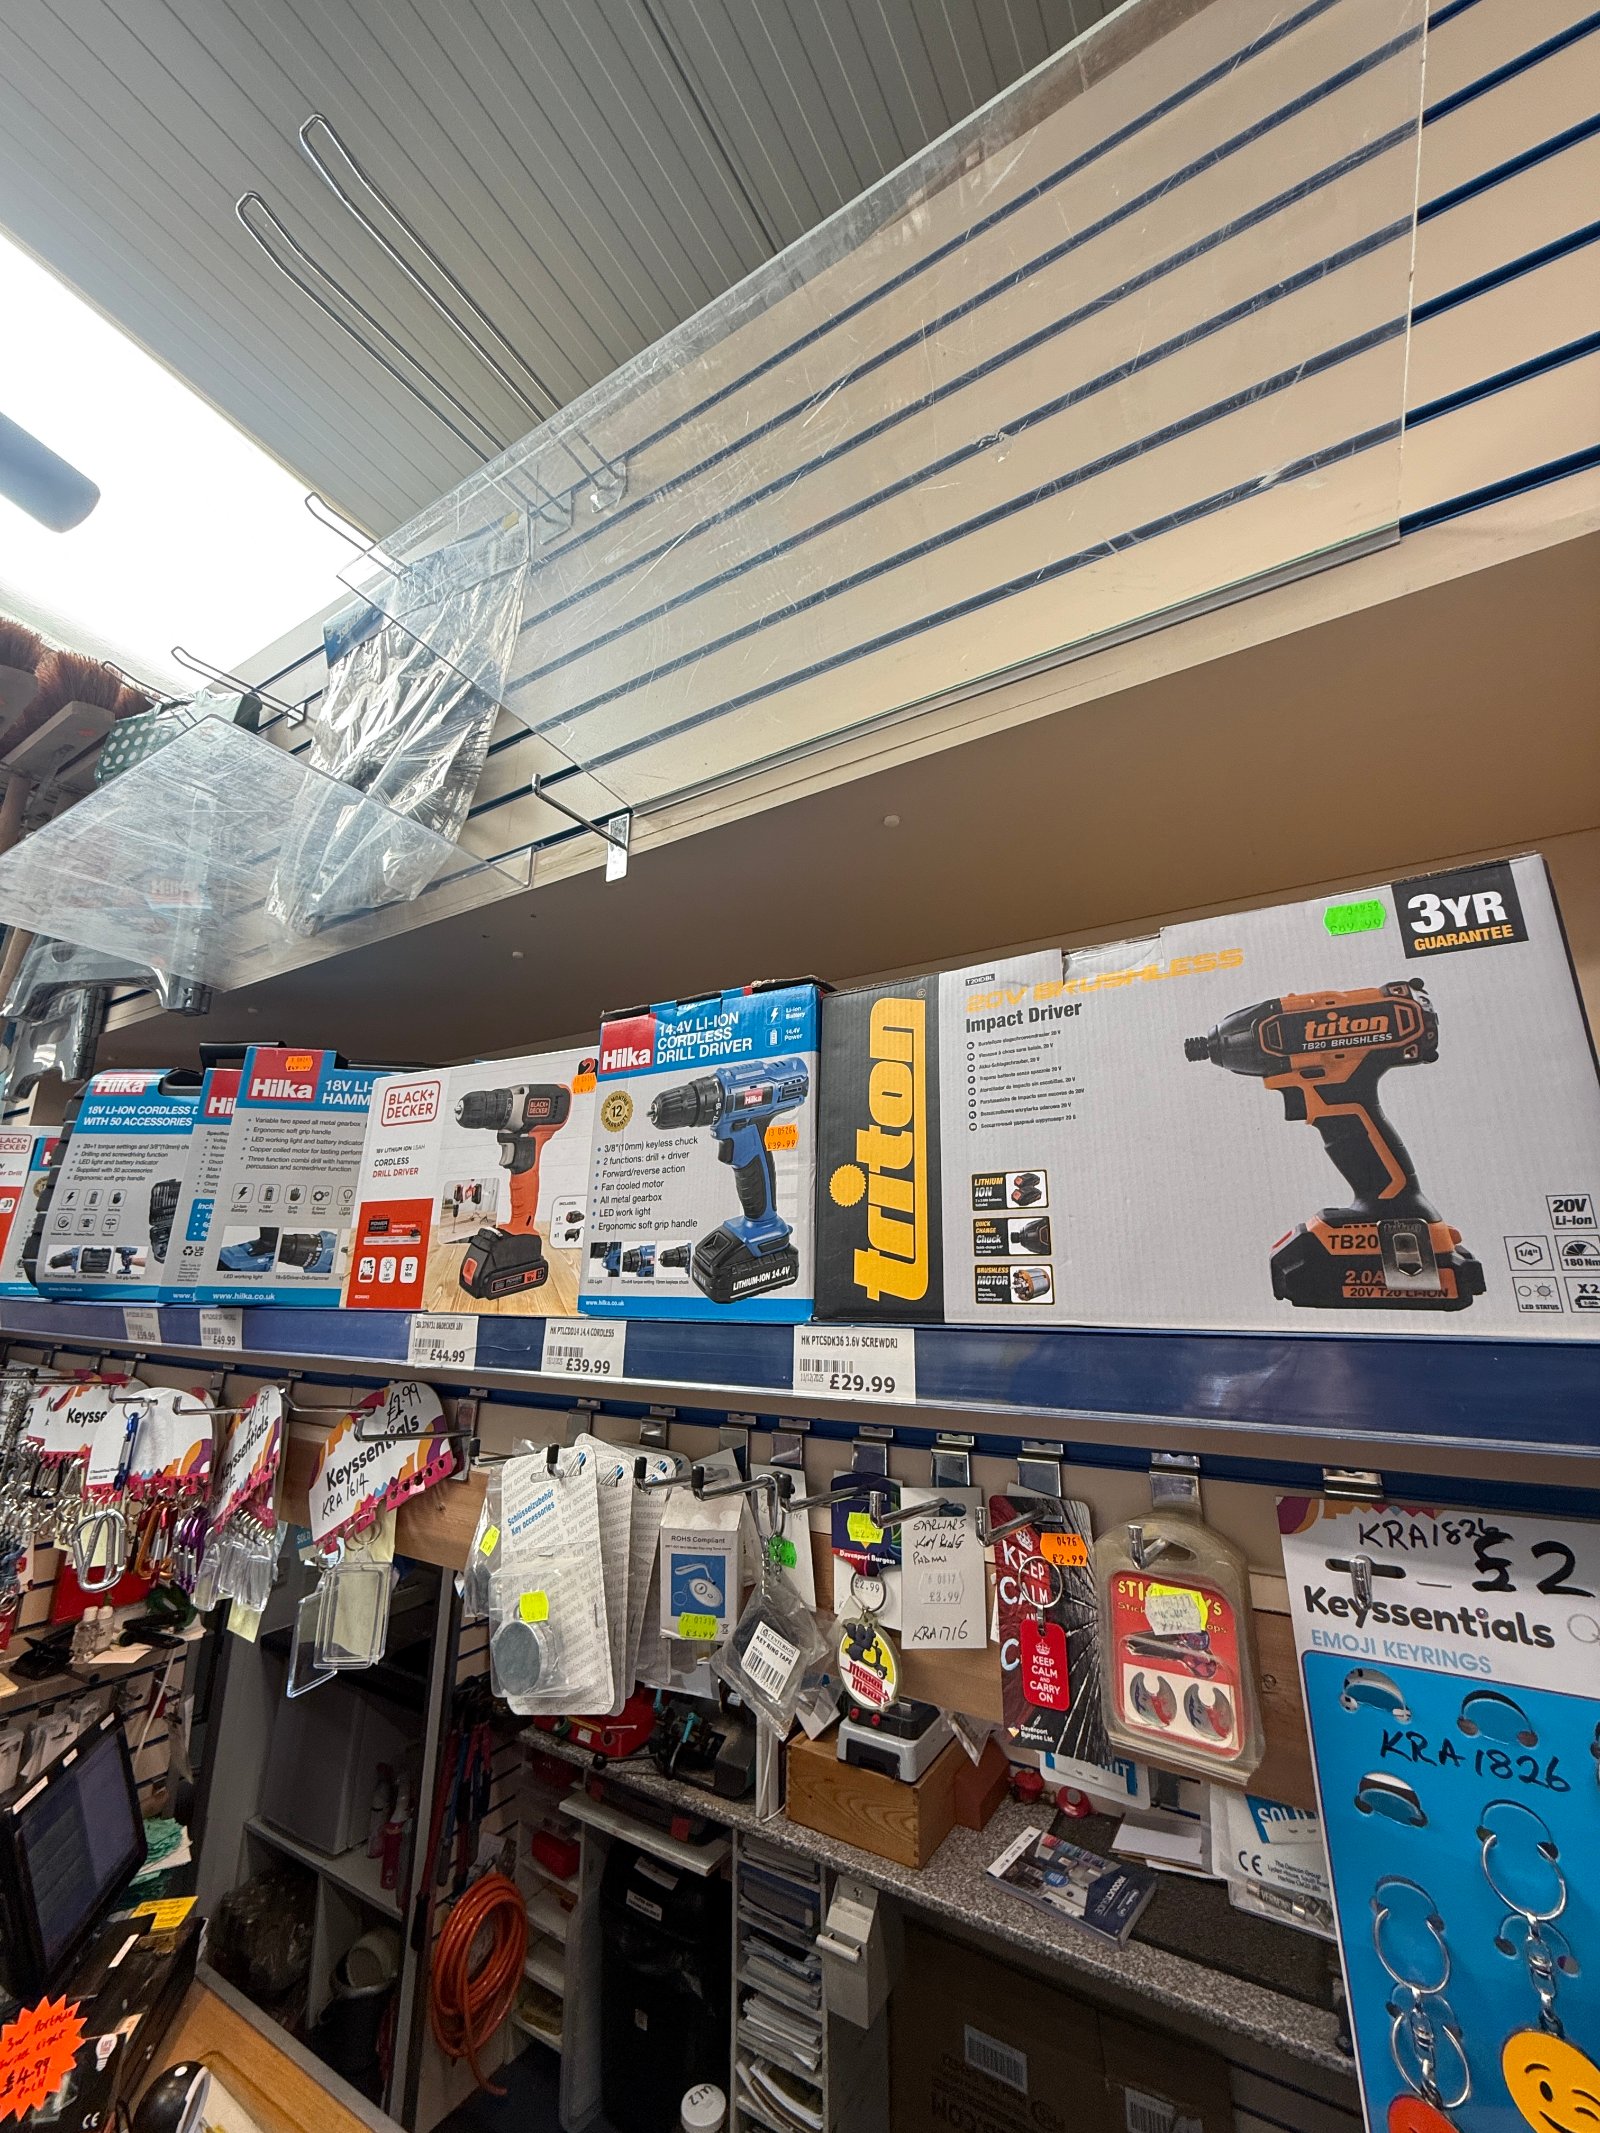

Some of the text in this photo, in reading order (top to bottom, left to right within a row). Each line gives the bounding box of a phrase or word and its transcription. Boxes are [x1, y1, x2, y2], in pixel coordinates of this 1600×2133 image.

[1407, 890, 1508, 934] 3YR
[1414, 924, 1514, 950] GUARANTEE
[967, 949, 1244, 1013] 20V BRUSHLESS
[659, 1011, 739, 1037] 14.4V LI-ION
[966, 1002, 1082, 1033] Impact Driver
[1305, 1012, 1389, 1042] triton
[657, 1027, 733, 1050] CORDLESS
[785, 1033, 803, 1042] Power
[1302, 1033, 1392, 1049] TB20 BRUSHLESS
[657, 1038, 752, 1064] DRILL DRIVER
[602, 1048, 650, 1071] Hilka
[251, 1078, 312, 1099] Hilka
[325, 1080, 351, 1092] 18V
[389, 1089, 434, 1105] BLACK+
[88, 1106, 104, 1115] 18V
[106, 1106, 135, 1115] LI-ION
[136, 1106, 190, 1115] CORDLESS
[387, 1102, 433, 1119] DECKER
[612, 1105, 622, 1117] 12
[84, 1117, 192, 1126] WITH 50 ACCESSORIES
[646, 1139, 673, 1150] keyless
[675, 1137, 698, 1146] chuck
[829, 997, 929, 1301] triton
[374, 1157, 409, 1167] CORDLESS
[603, 1158, 608, 1166] 2
[609, 1155, 643, 1165] functions:
[645, 1152, 659, 1161] drill
[668, 1151, 689, 1159] driver
[373, 1168, 418, 1178] DRILL DRIVER
[603, 1165, 685, 1178] Forward/reverse action
[601, 1180, 664, 1191] Fan cooled motor
[975, 1187, 992, 1197] ION
[600, 1193, 662, 1204] All metal gearbox
[1552, 1199, 1588, 1212] 20V
[599, 1209, 614, 1217] LED
[635, 1207, 651, 1217] light
[598, 1219, 697, 1232] Ergonomic soft grip handle
[1555, 1215, 1592, 1225] Li-Ion
[1328, 1234, 1378, 1250] TB20
[1519, 1249, 1537, 1257] 1/4"
[1563, 1258, 1583, 1266] 180
[733, 1266, 790, 1290] LITHIUM-ION 14.4V
[213, 1292, 275, 1300] www.hilka.co.uk
[1350, 1288, 1373, 1297] 20V
[1379, 1288, 1401, 1297] T20
[591, 1328, 614, 1337] CORDLESS
[213, 1336, 235, 1346] £49.99
[801, 1335, 810, 1345] HK
[811, 1336, 844, 1346] PTCSDK36
[846, 1336, 860, 1347] 3.6V
[430, 1348, 465, 1363] £44.99
[566, 1358, 610, 1374] £39.99
[829, 1374, 895, 1393] £29.99
[508, 1489, 554, 1526] Schlüsselzubehör
[511, 1501, 555, 1536] Key accessories
[840, 1550, 895, 1565] Davenport Burgess
[1002, 1539, 1045, 1580] KEEP
[1052, 1554, 1084, 1564] £2.99
[855, 1579, 880, 1593] £2.99
[1304, 1584, 1555, 1649] Keyssentials
[912, 1620, 968, 1641] KRA1716
[756, 1635, 792, 1665] KEY RING TAPE
[1311, 1629, 1492, 1674] EMOJI KEYRINGS
[1033, 1655, 1054, 1667] KEEP
[1031, 1666, 1057, 1678] CALM
[1030, 1681, 1060, 1695] CARRY
[1039, 1693, 1053, 1703] ON
[1021, 1725, 1048, 1734] Davenport
